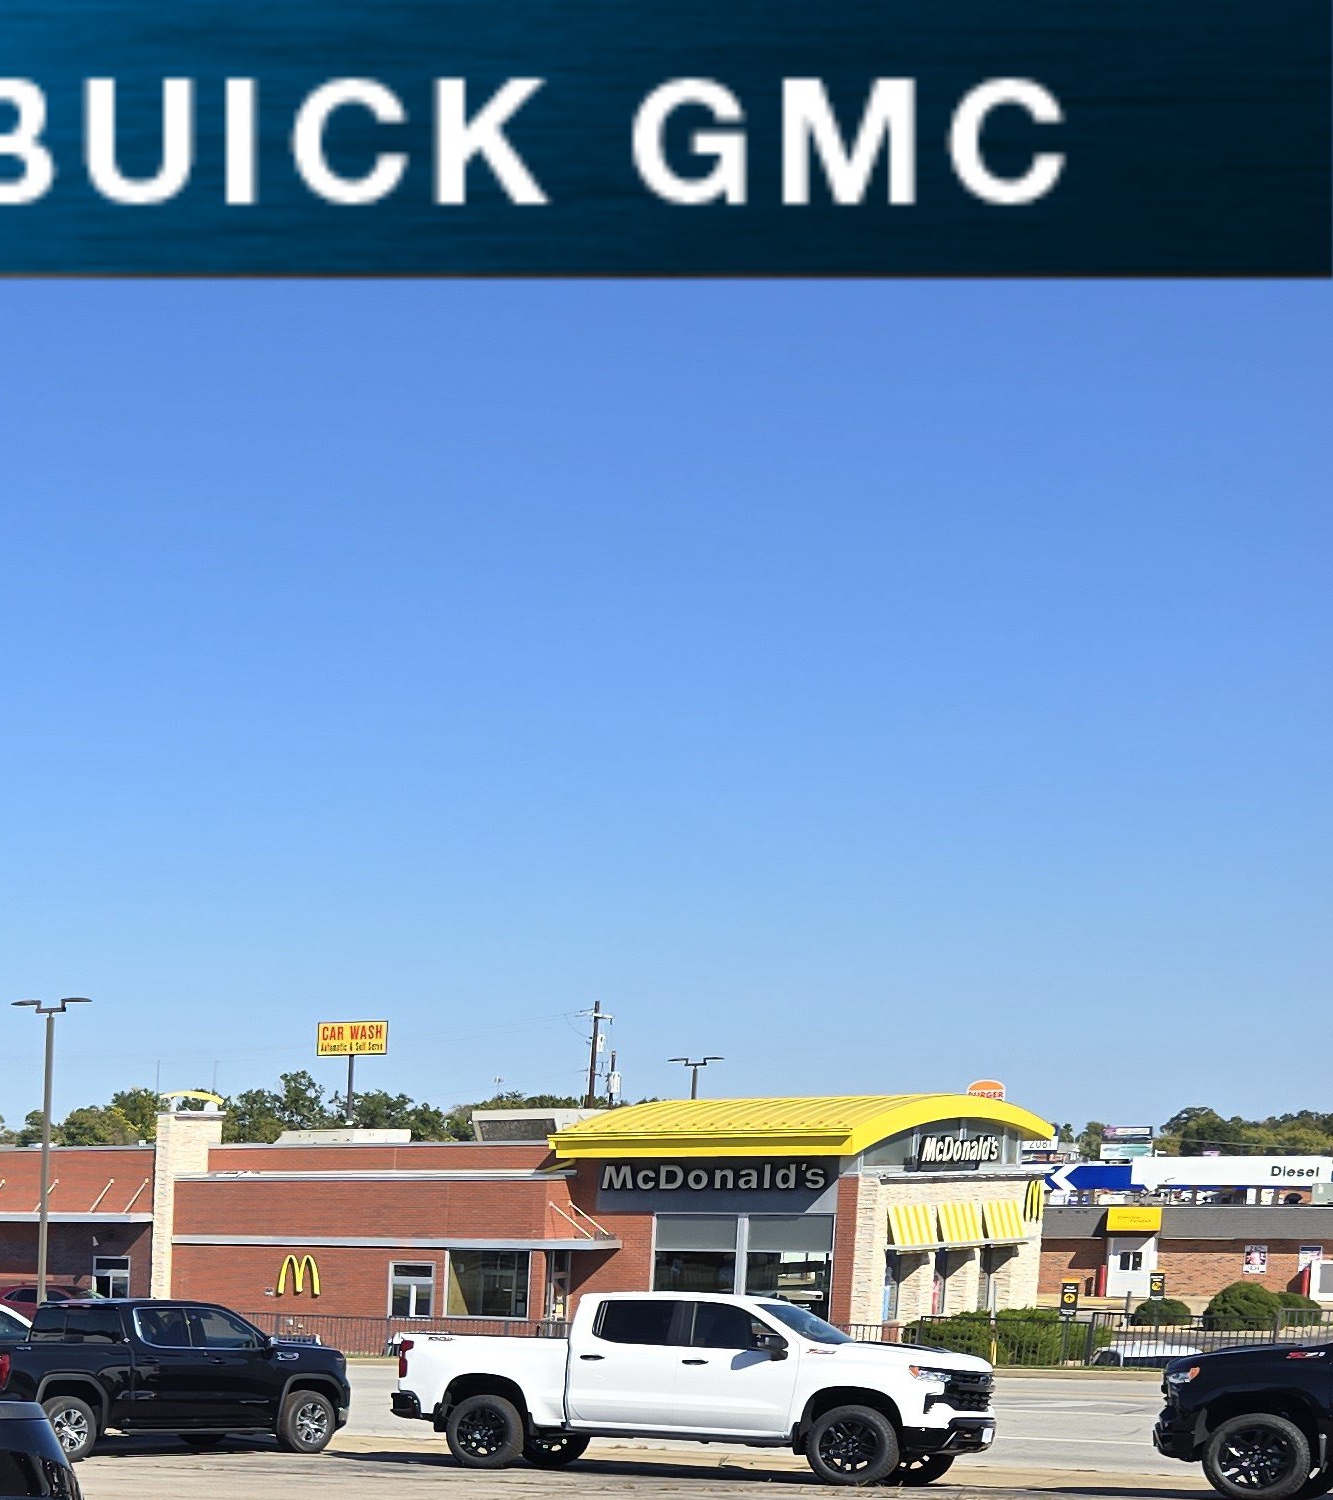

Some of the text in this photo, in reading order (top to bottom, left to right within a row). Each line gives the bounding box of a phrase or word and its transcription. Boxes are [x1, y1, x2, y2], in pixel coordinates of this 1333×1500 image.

[322, 1024, 383, 1040] CAR WASH
[921, 1135, 999, 1163] McDonald's
[600, 1163, 826, 1190] McDonald's
[1270, 1165, 1320, 1177] Diesel
